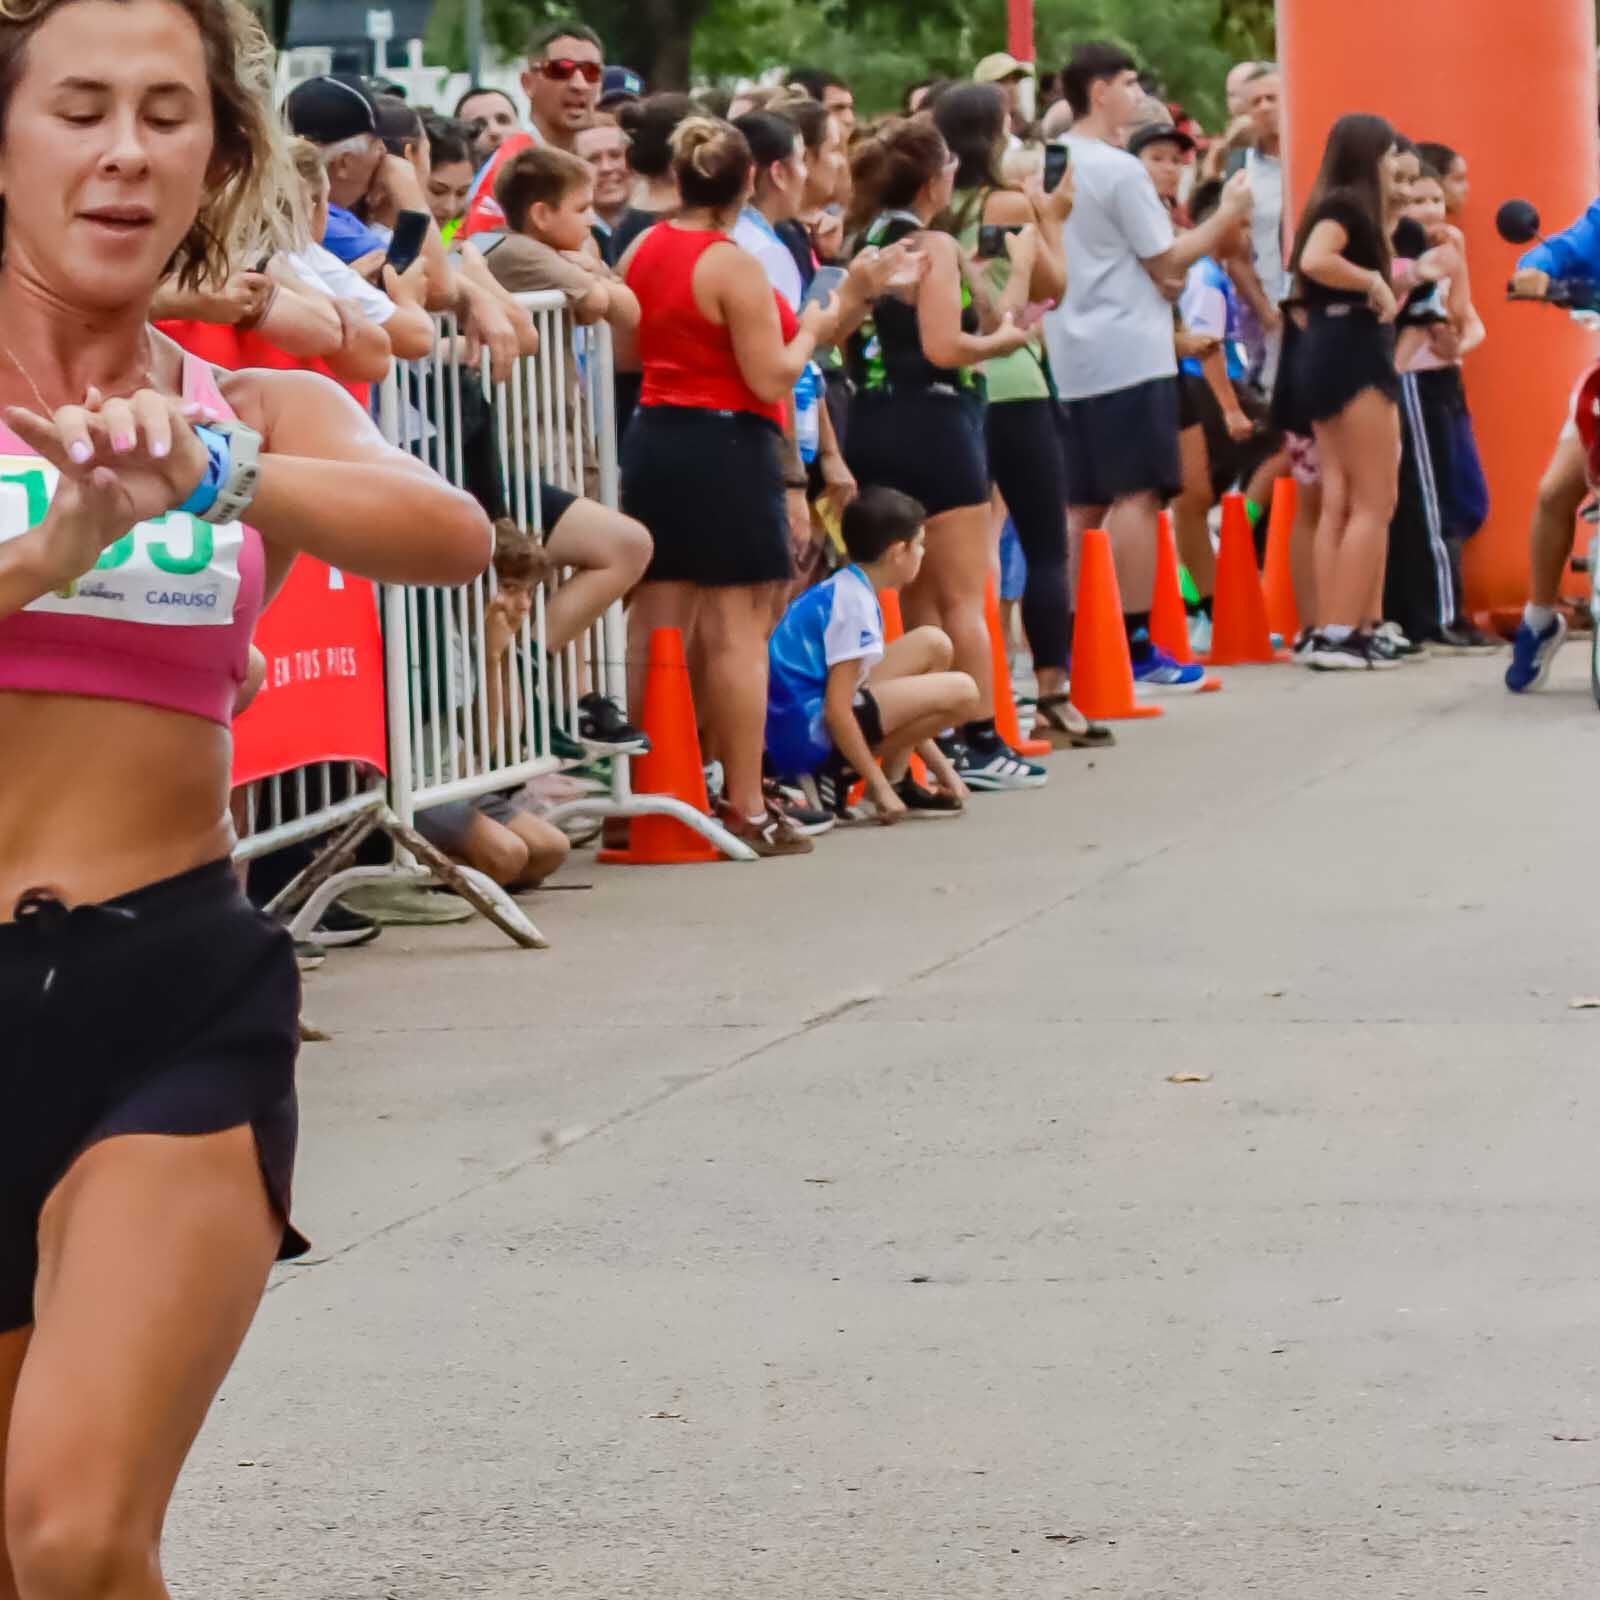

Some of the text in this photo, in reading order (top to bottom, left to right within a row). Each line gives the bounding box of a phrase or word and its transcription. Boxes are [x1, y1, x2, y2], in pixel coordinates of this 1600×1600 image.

[0, 468, 214, 575] 15
[145, 590, 218, 608] CARUSO
[295, 648, 321, 681] TUS
